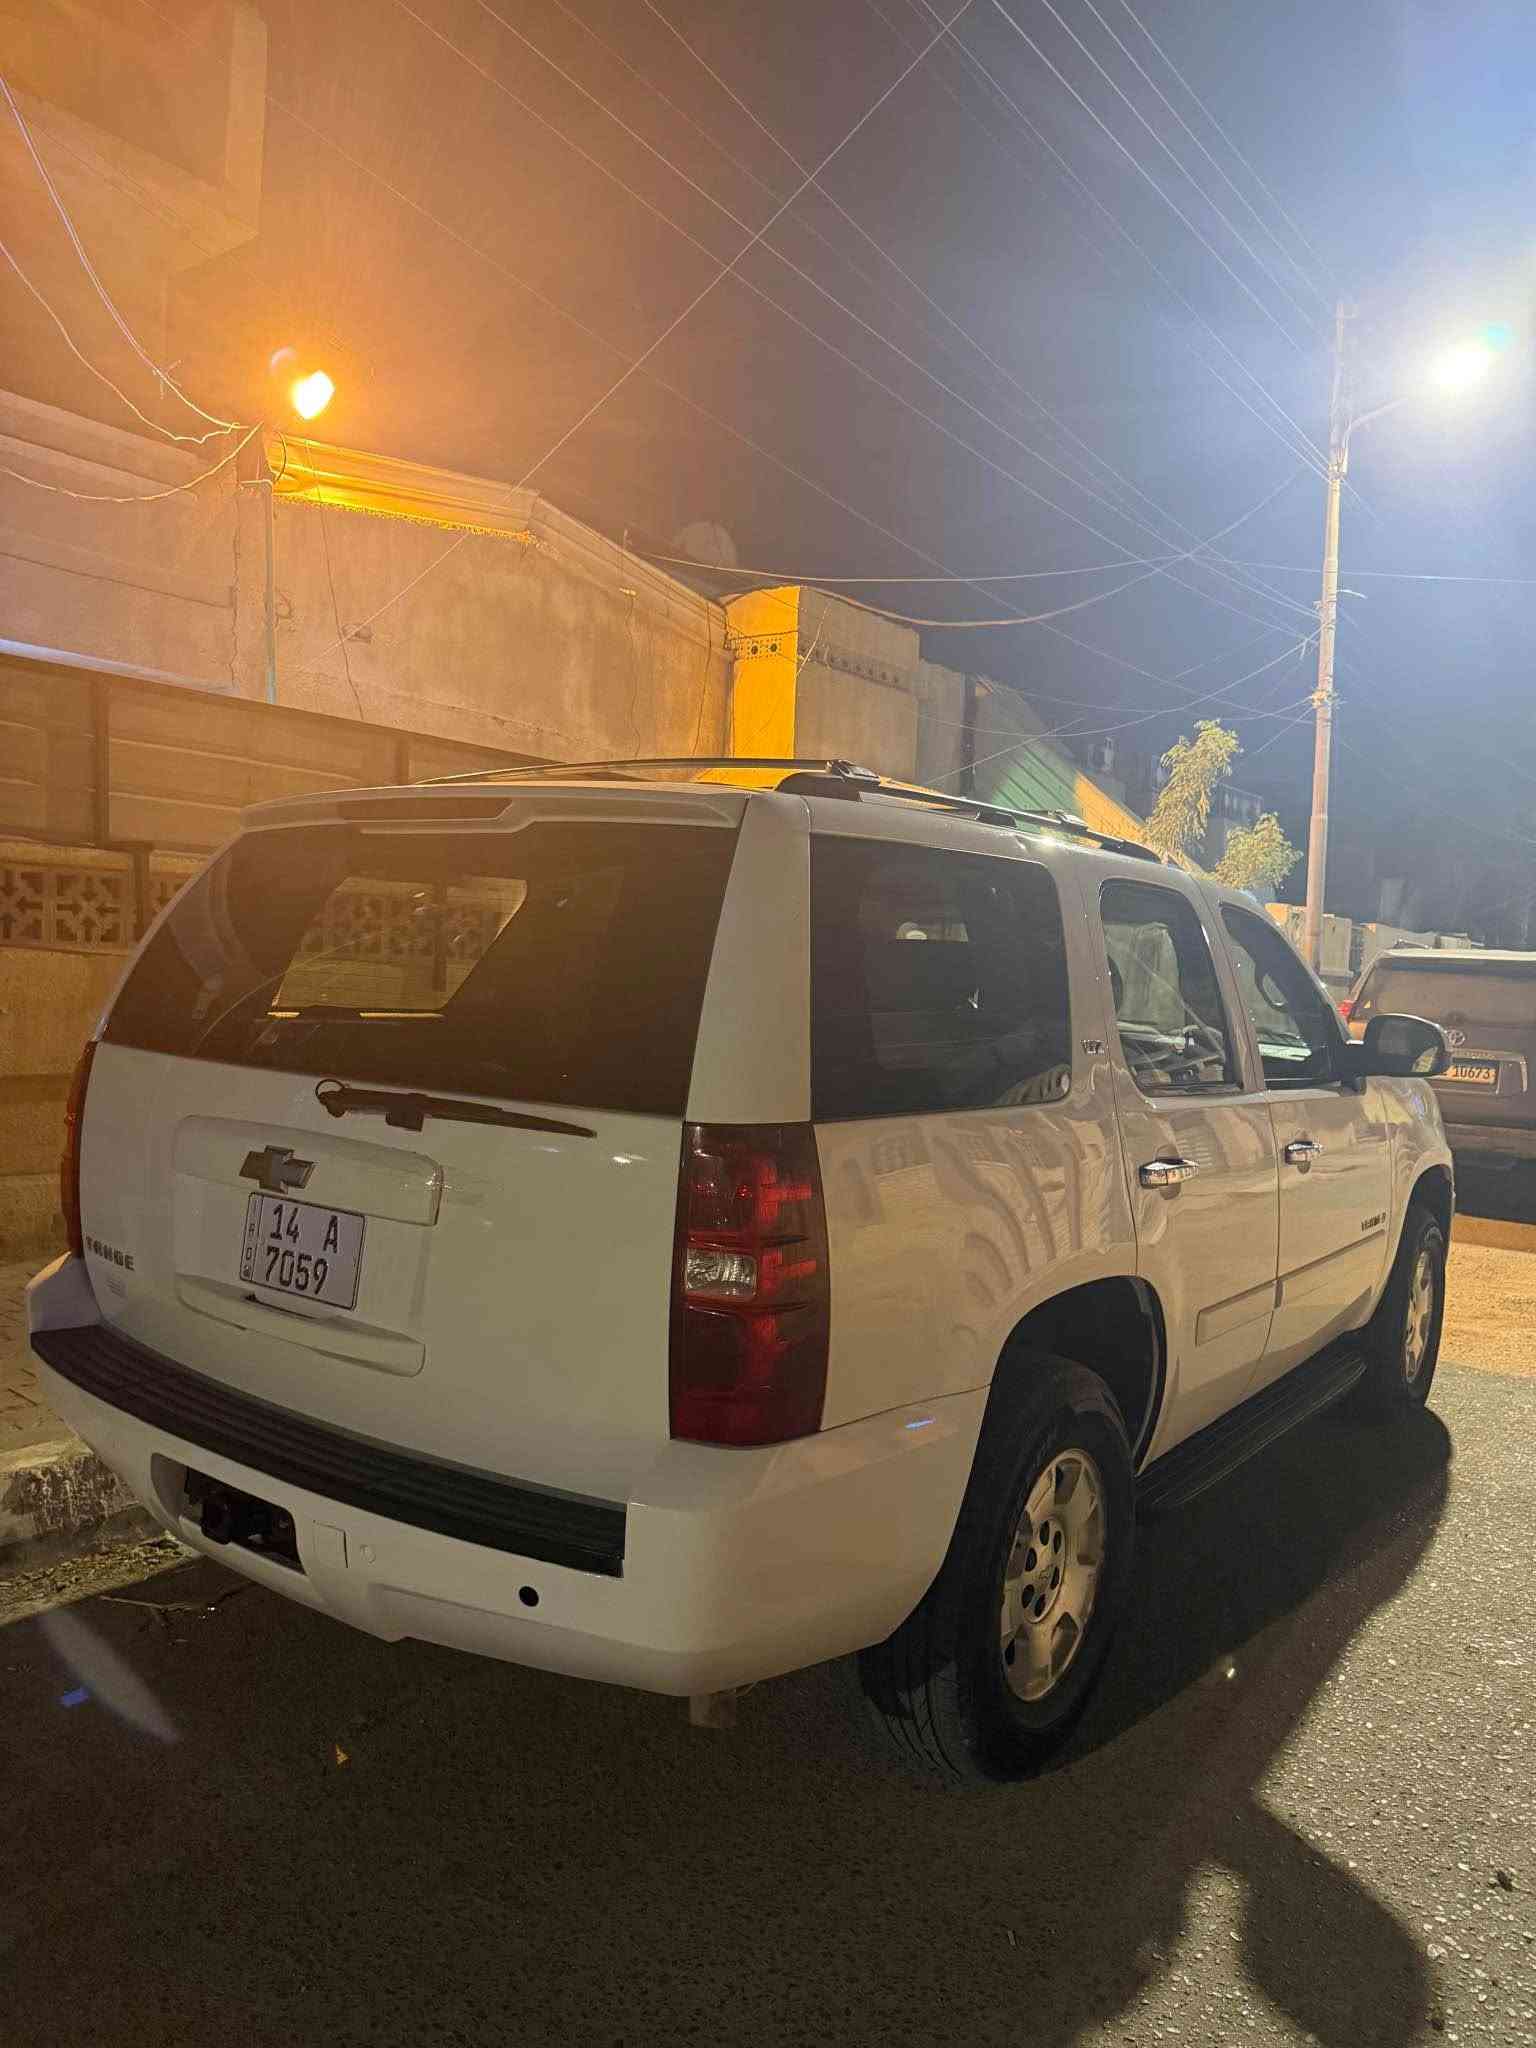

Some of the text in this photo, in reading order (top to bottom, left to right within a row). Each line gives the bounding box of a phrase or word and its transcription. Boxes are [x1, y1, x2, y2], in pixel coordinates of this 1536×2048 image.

[270, 1203, 338, 1254] 14 A
[265, 1245, 328, 1295] 7059
